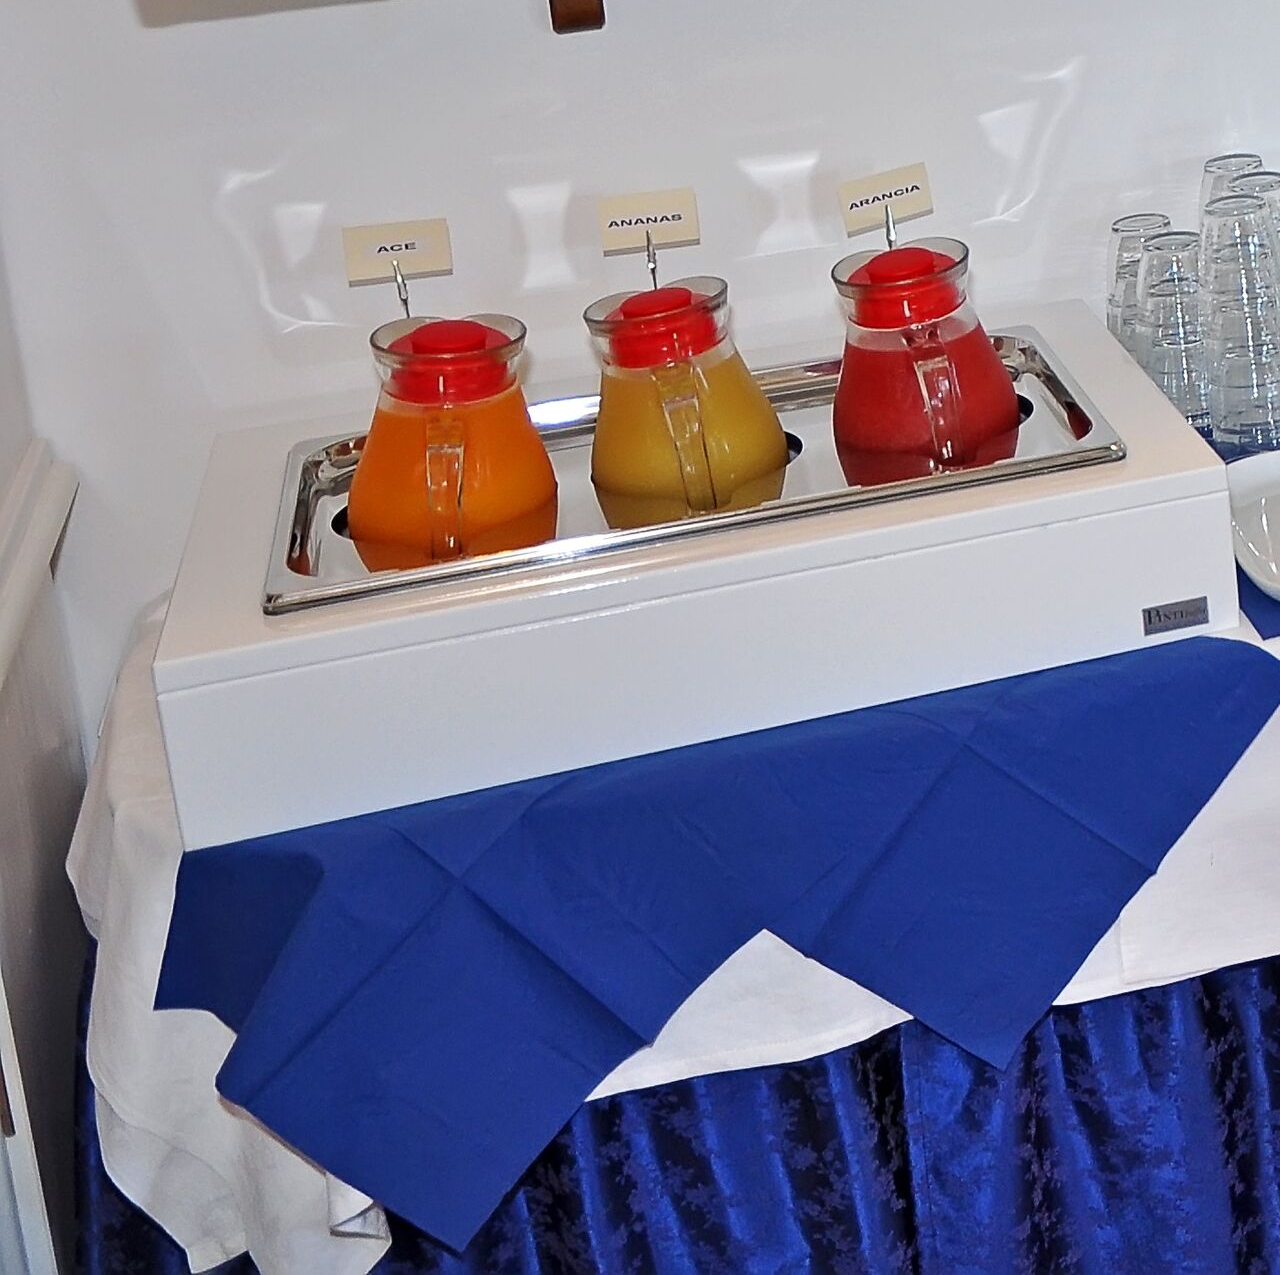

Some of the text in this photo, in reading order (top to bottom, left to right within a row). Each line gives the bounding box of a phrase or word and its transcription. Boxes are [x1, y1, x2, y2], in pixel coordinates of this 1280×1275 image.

[849, 184, 921, 210] ARANCIA
[608, 213, 682, 228] ANANAS
[376, 242, 417, 254] ACE
